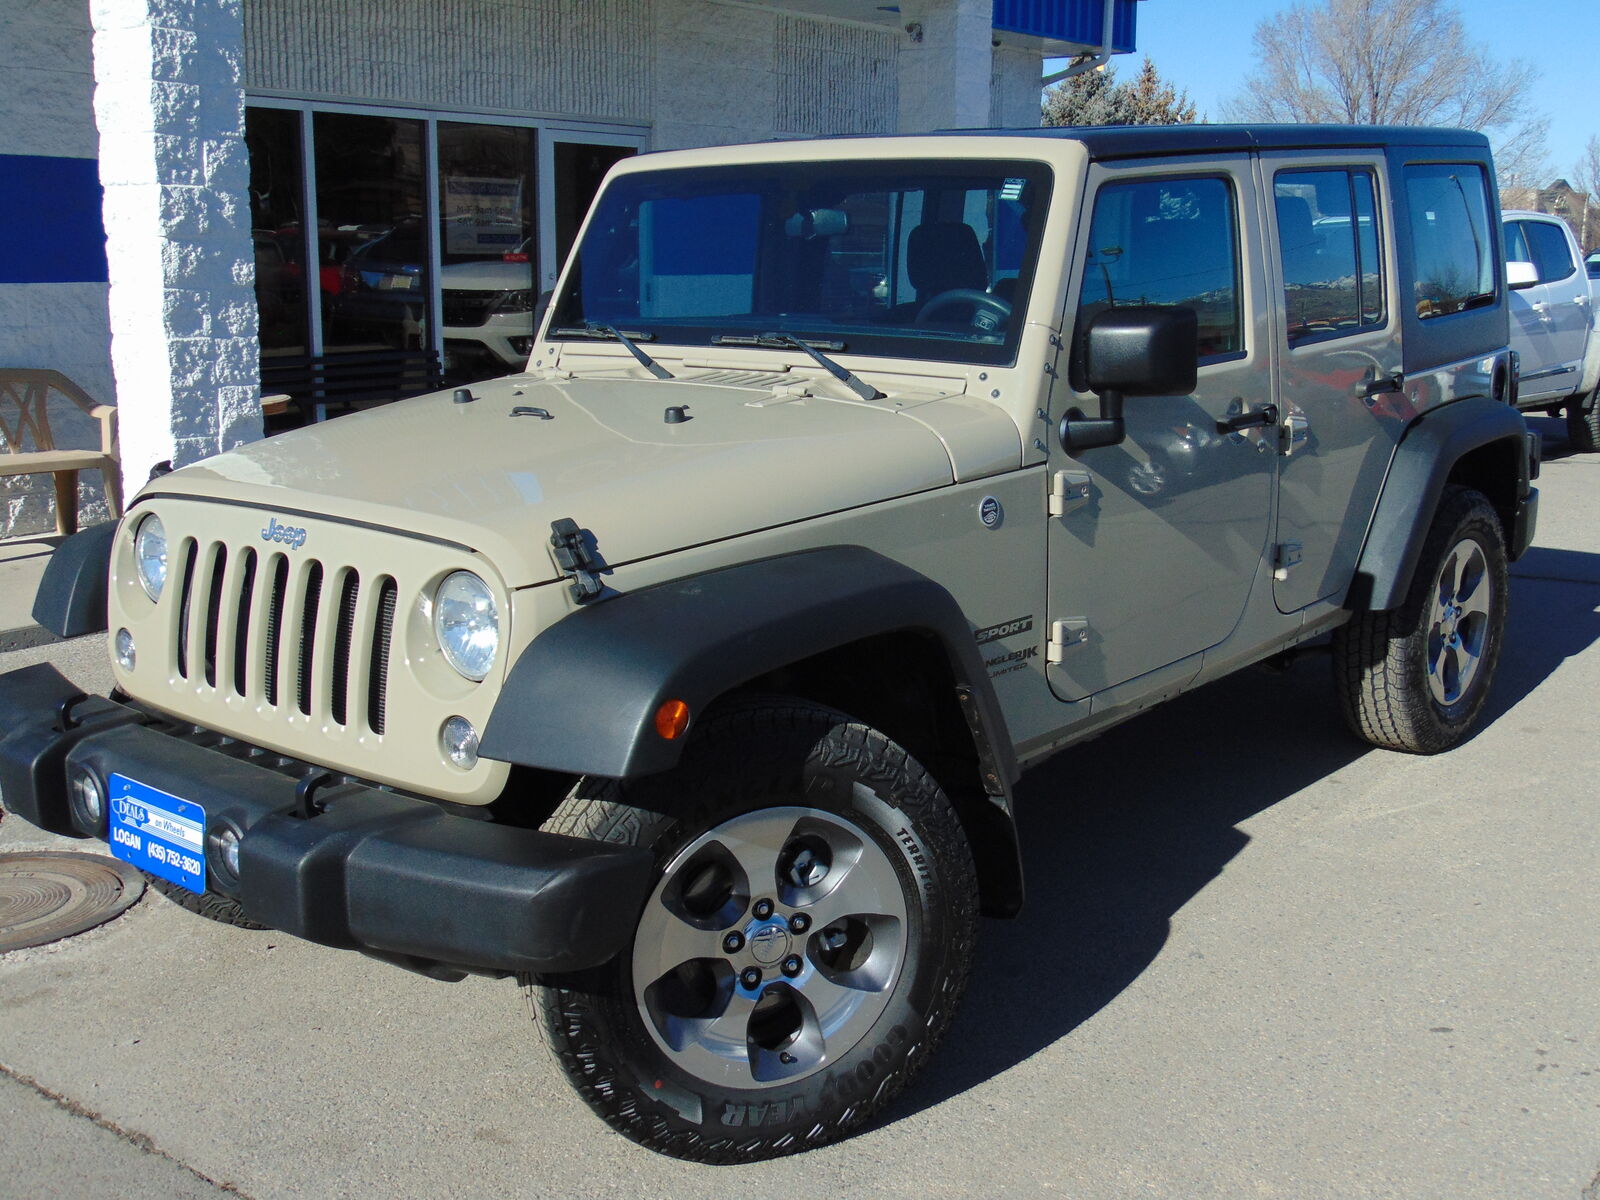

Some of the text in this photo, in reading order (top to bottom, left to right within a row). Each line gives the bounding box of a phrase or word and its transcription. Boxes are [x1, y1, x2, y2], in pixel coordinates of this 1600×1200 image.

[261, 517, 306, 551] Jeep
[976, 616, 1033, 643] SPORT
[119, 800, 185, 838] DEALS on Wheels
[113, 826, 141, 851] LOGAN
[147, 841, 166, 865] (435)
